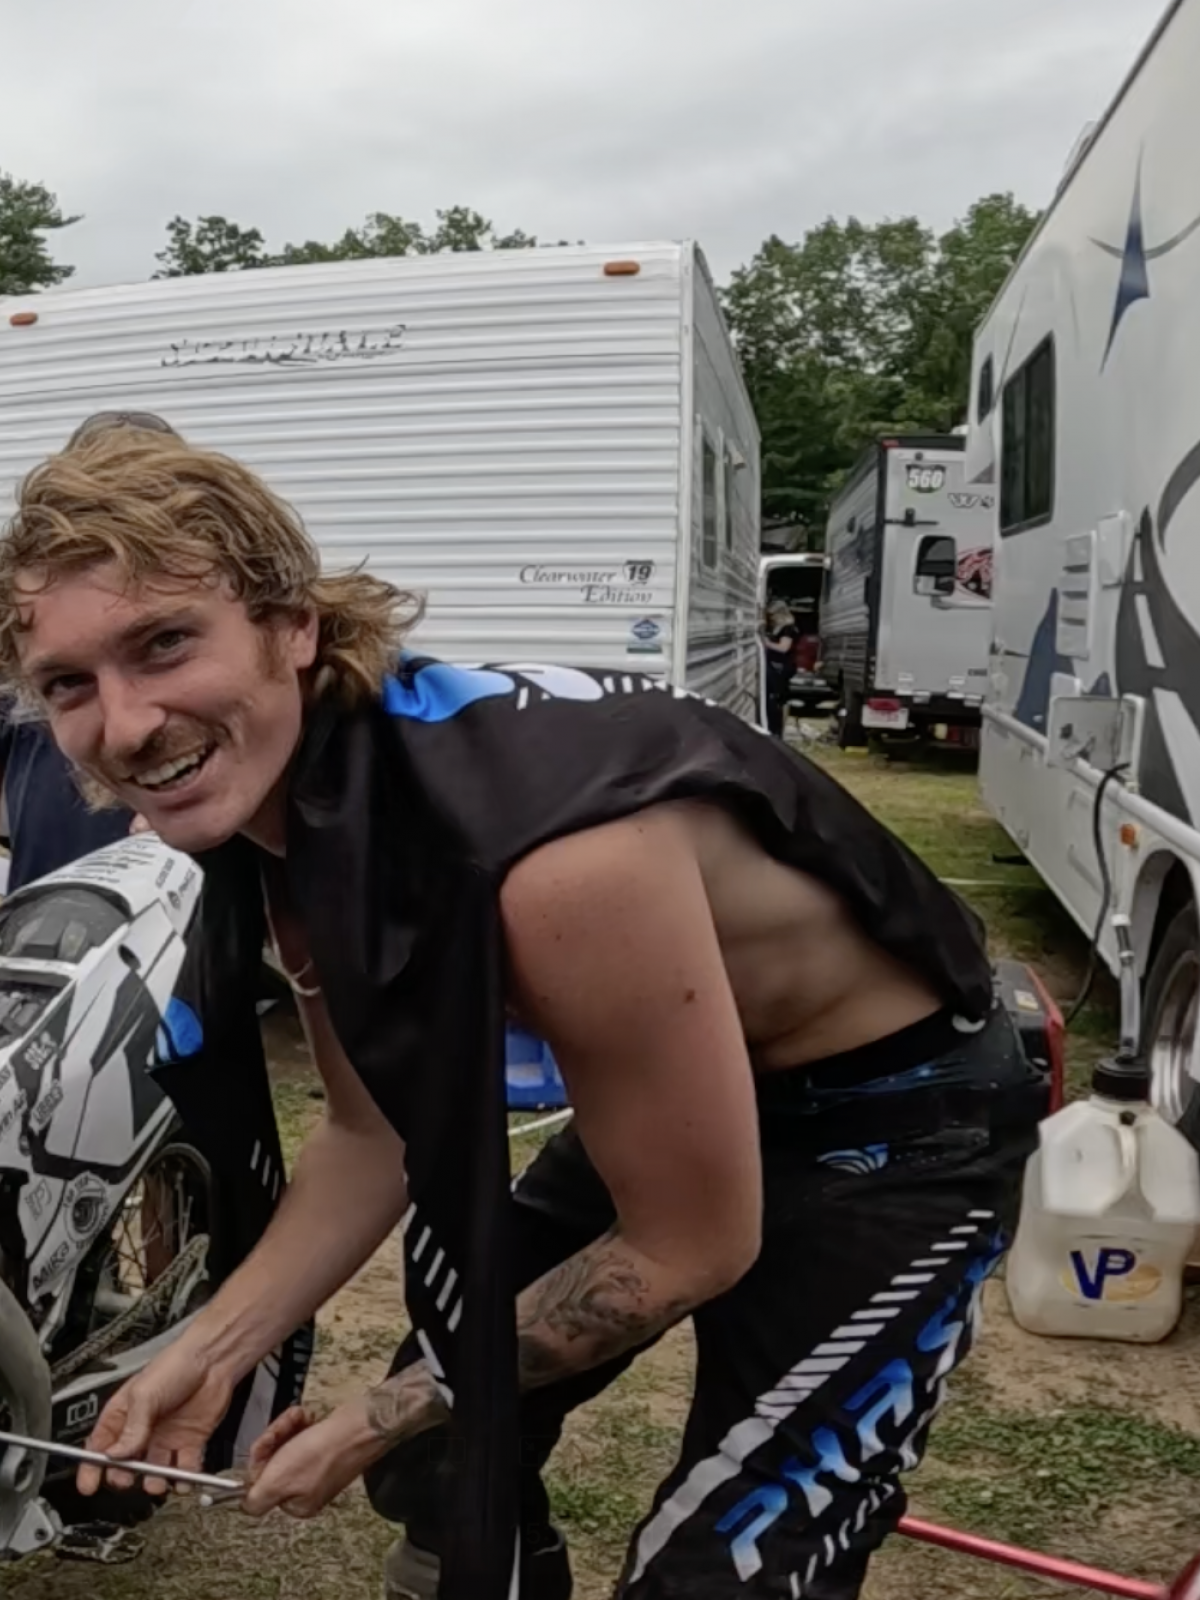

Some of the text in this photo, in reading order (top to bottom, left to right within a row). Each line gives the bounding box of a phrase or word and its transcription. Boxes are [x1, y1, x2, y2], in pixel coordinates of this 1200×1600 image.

[908, 467, 944, 489] 560
[518, 563, 653, 584] Clearwater 19
[579, 583, 654, 604] Edition
[1069, 1247, 1137, 1301] VP
